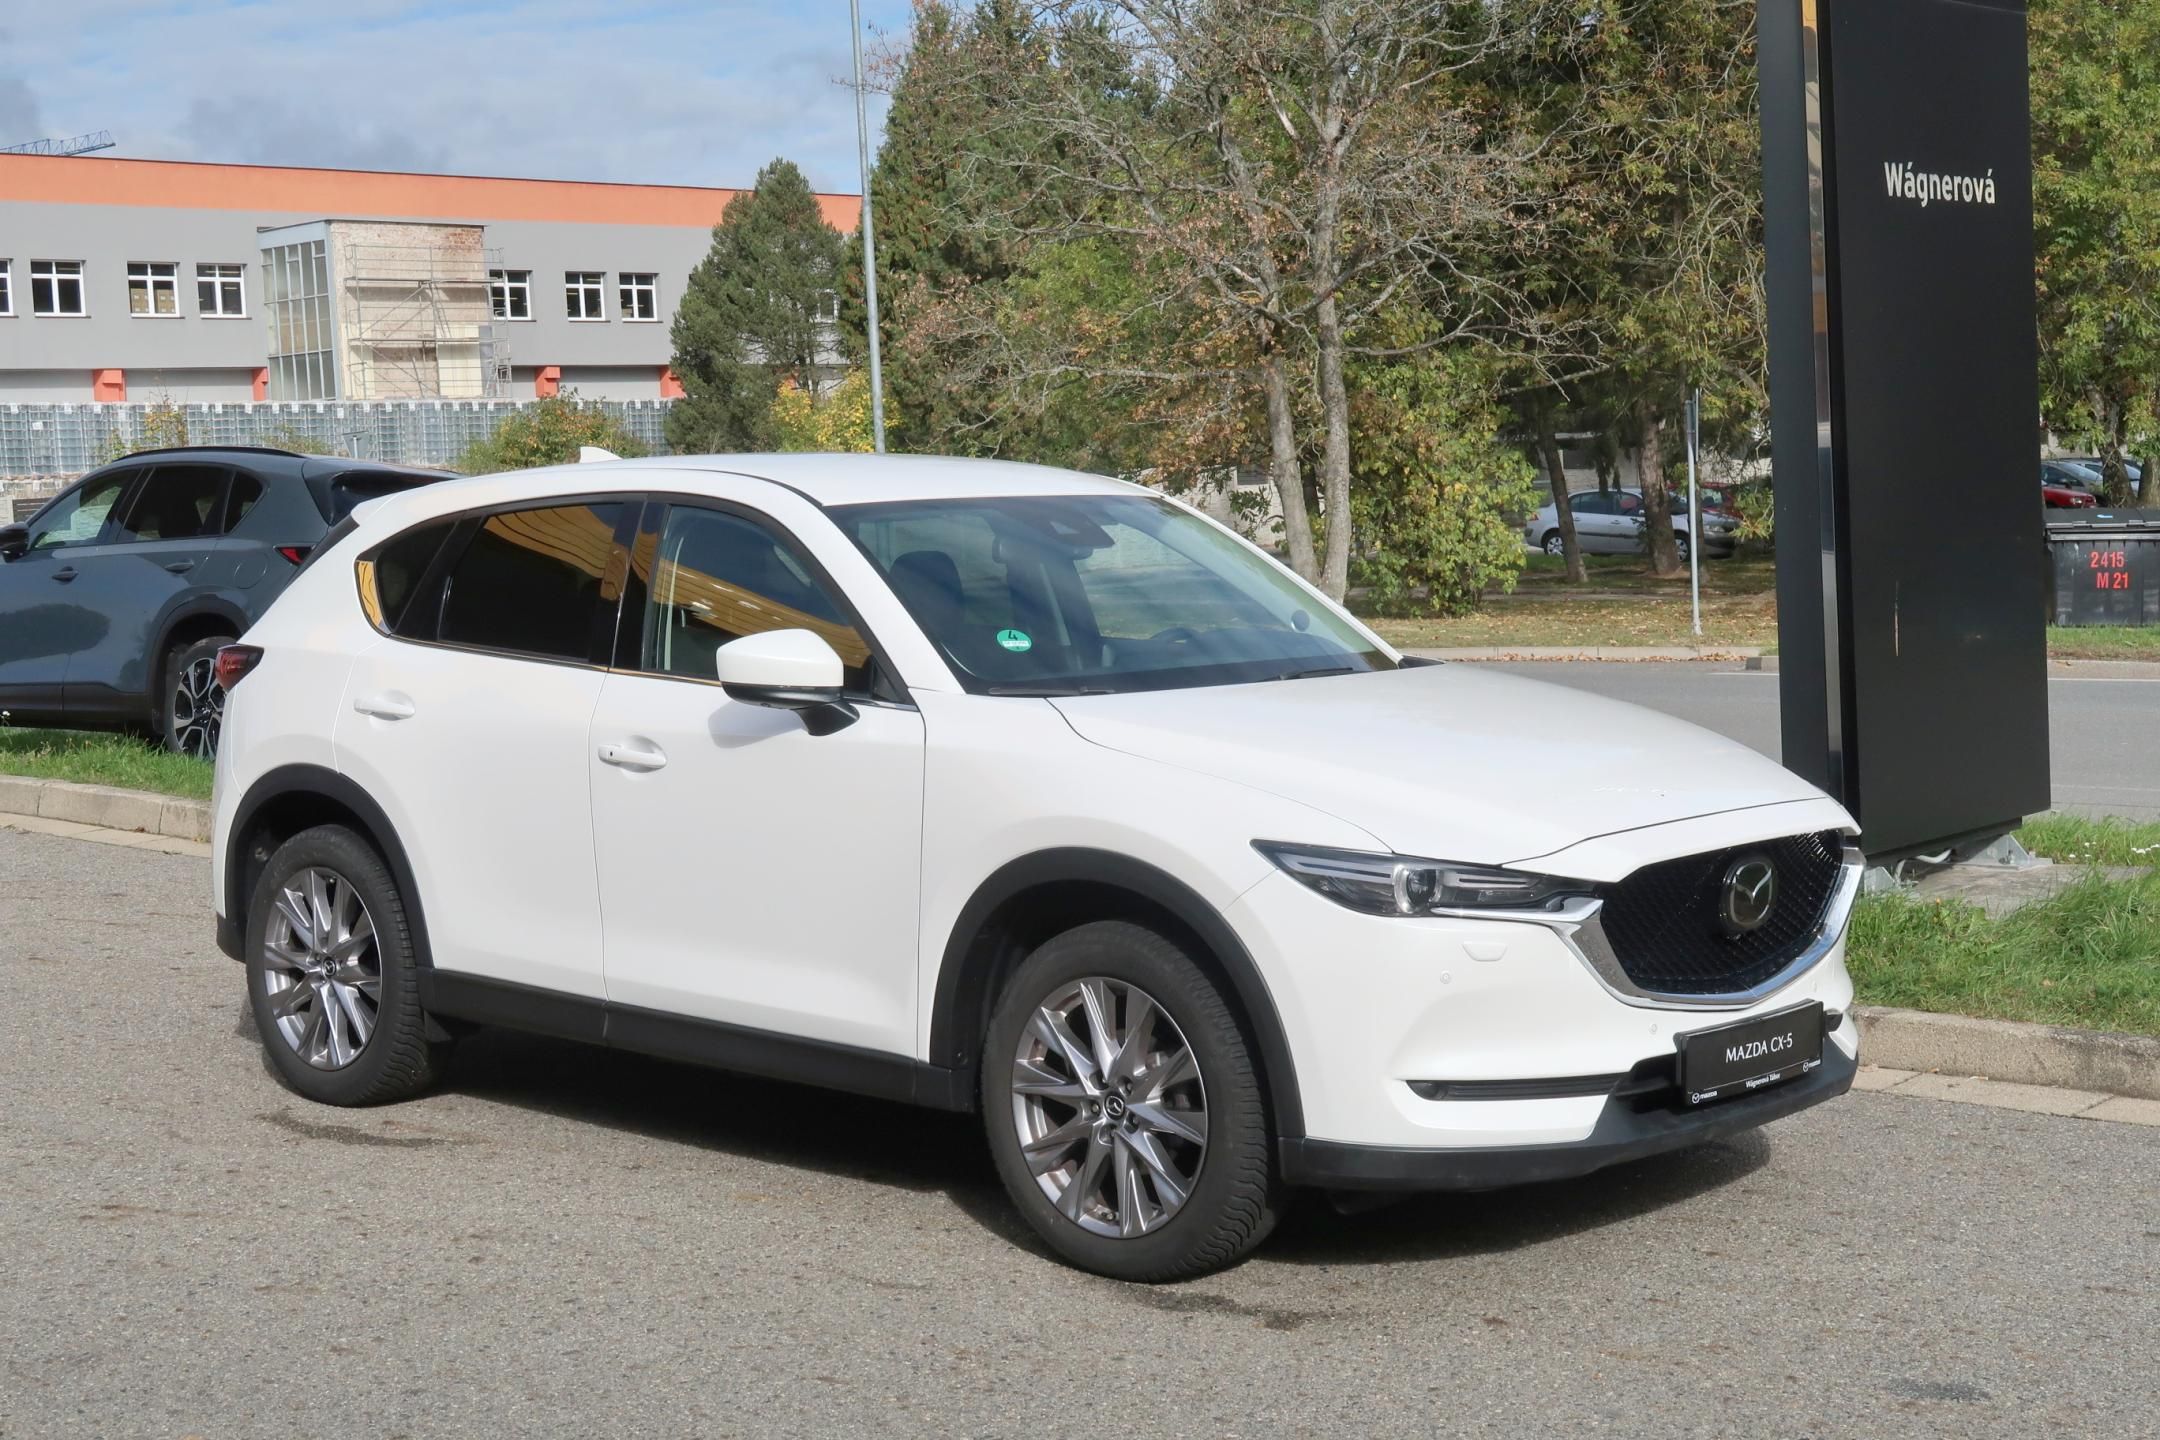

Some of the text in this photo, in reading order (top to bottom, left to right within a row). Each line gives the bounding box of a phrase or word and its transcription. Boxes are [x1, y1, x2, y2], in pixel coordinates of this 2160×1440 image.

[1884, 161, 1996, 208] Wágnerová
[2091, 551, 2125, 568] 2415
[2096, 572, 2129, 589] M 21
[1007, 630, 1018, 641] 4
[1725, 1032, 1793, 1064] MAZDA CX-5
